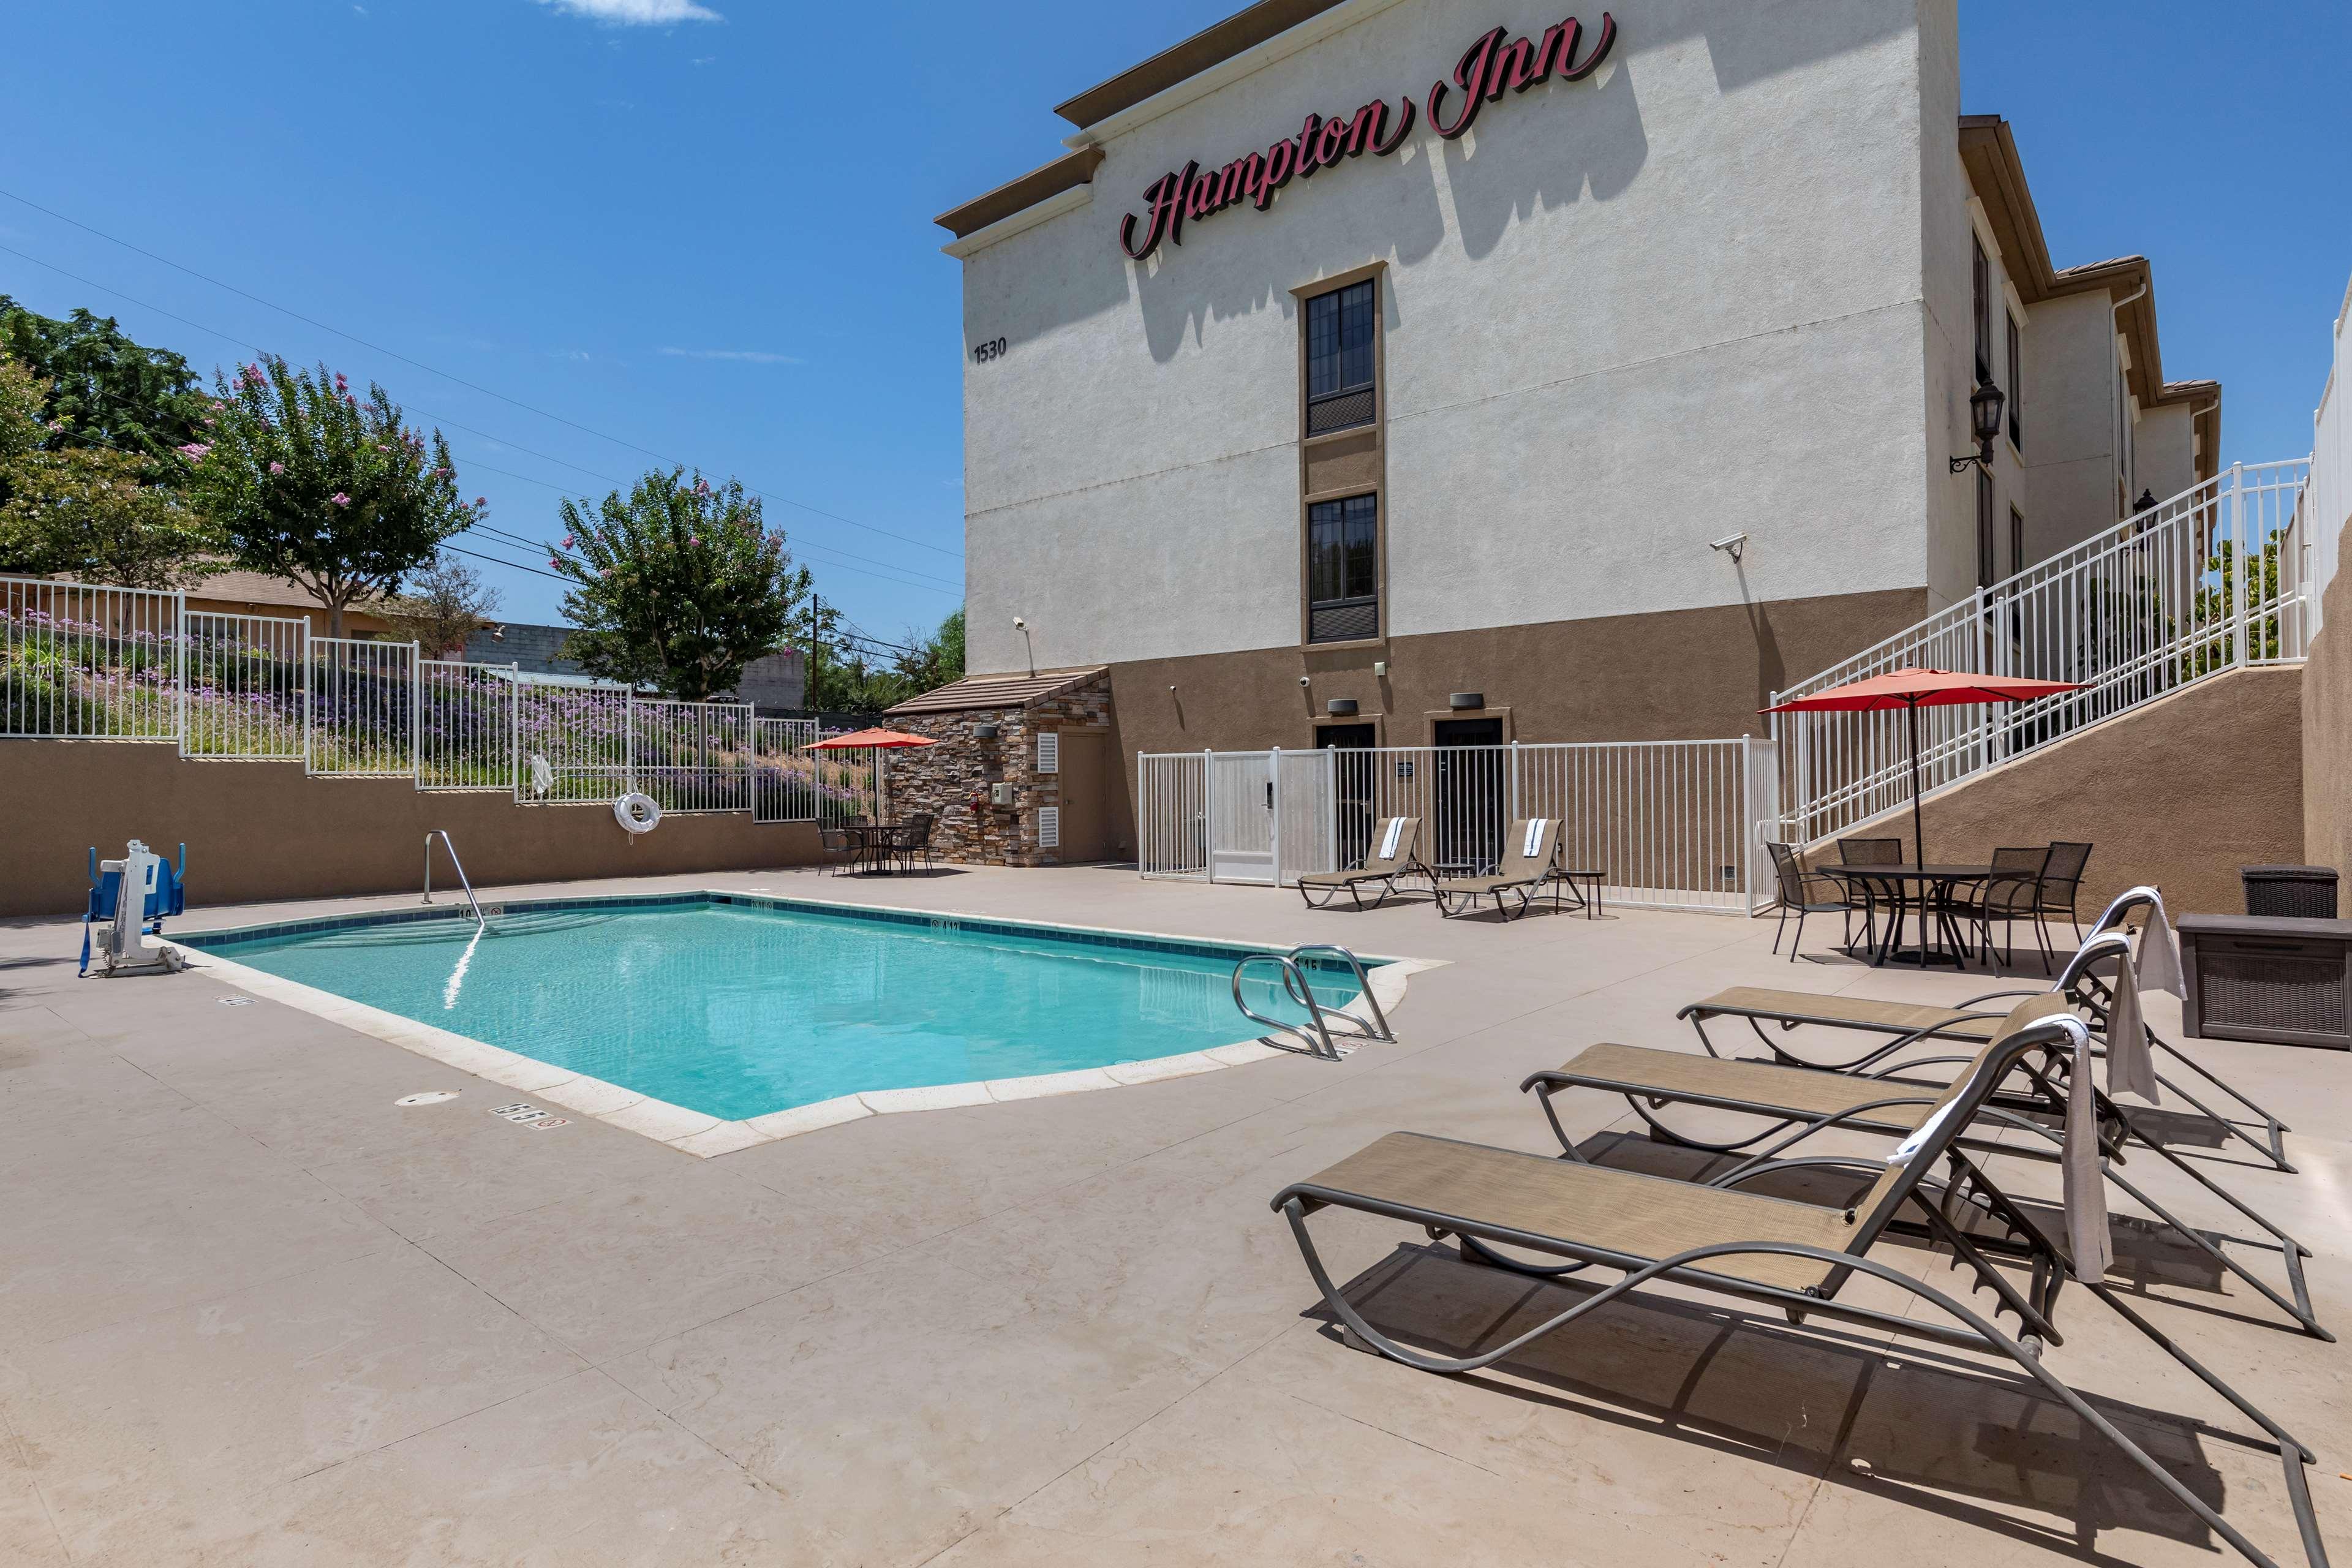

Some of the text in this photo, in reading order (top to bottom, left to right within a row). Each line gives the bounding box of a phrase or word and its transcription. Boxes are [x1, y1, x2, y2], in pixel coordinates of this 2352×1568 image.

[1120, 12, 1618, 262] Hampton Inn
[974, 337, 1006, 363] 1530
